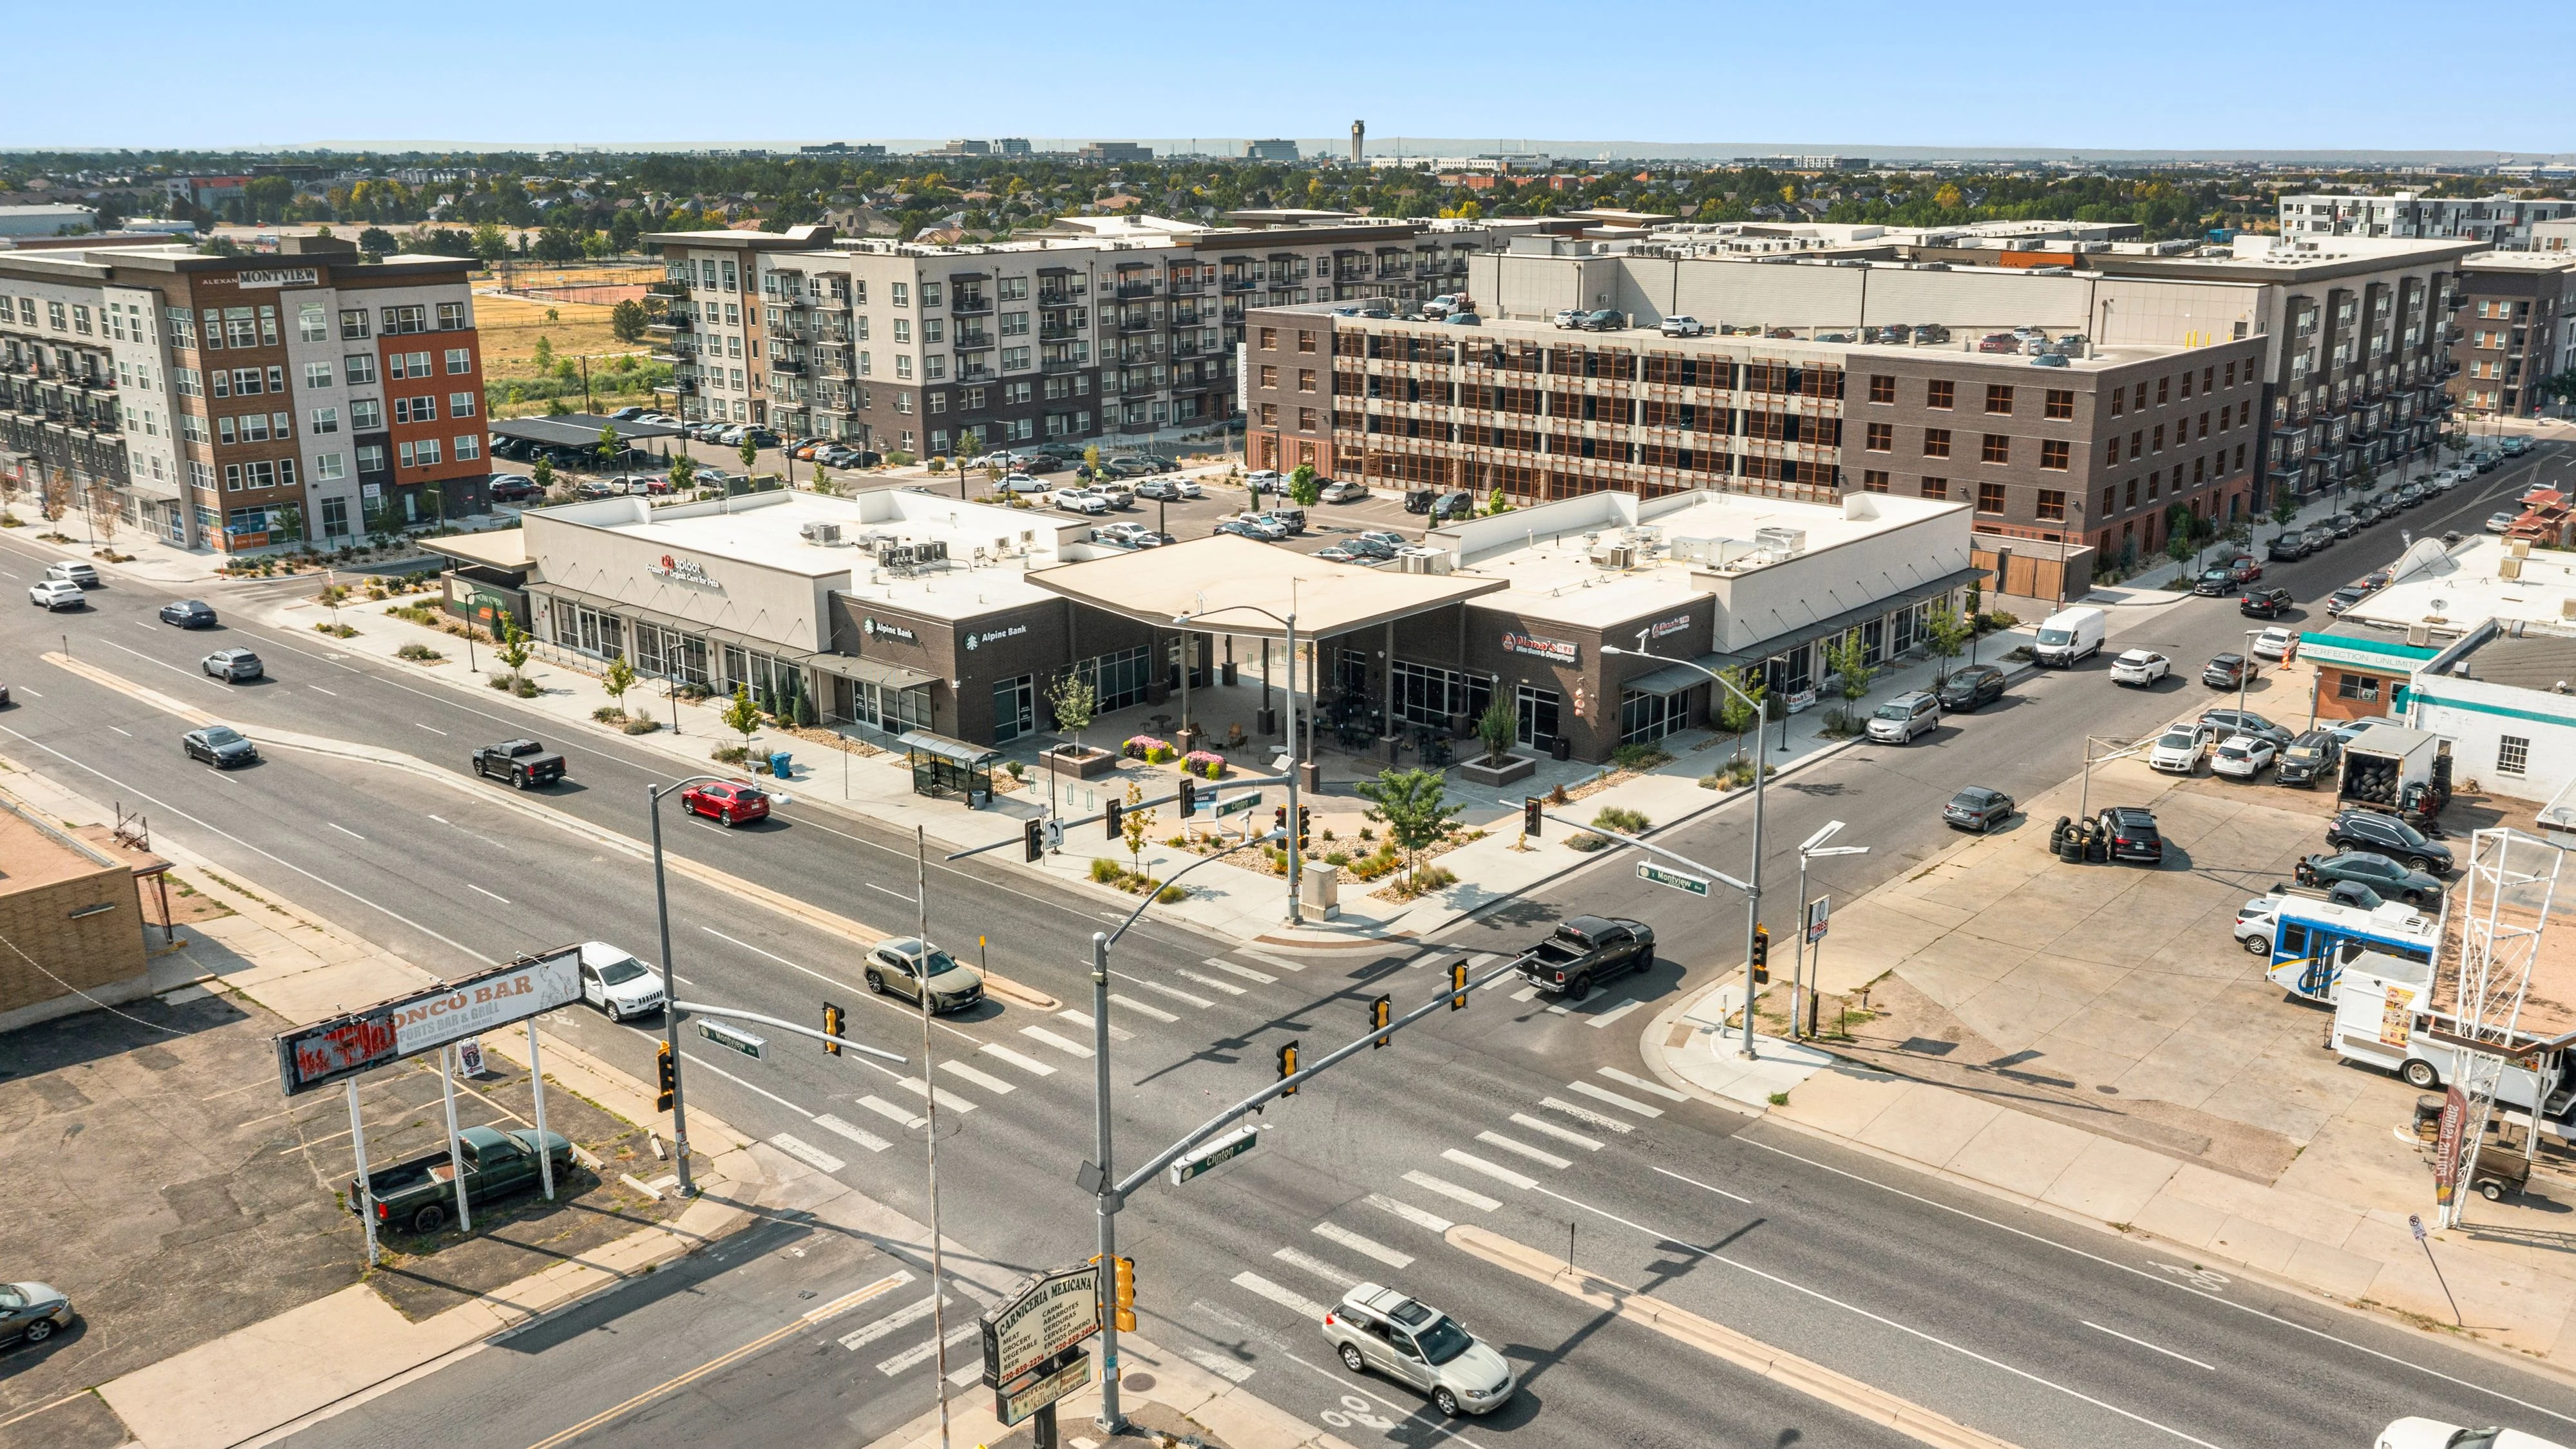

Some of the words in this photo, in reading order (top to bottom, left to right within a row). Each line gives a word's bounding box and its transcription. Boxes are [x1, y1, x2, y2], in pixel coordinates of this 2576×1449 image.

[240, 268, 316, 283] MONTVIEW
[676, 559, 701, 573] sploot
[645, 564, 666, 576] Primary
[670, 569, 687, 580] Urgent
[687, 574, 699, 583] Care
[699, 576, 707, 585] for
[707, 578, 719, 587] Pets
[876, 622, 896, 636] Alpine
[896, 627, 913, 638] Bank
[981, 631, 1007, 643] Alpine
[1008, 625, 1027, 636] Bank
[1517, 636, 1557, 652] Nana's
[1546, 651, 1575, 663] Dumplings
[2307, 647, 2369, 662] PERFECTION
[1048, 838, 1060, 846] ONLY
[1658, 871, 1691, 887] Montview
[1811, 919, 1827, 935] TIRES
[393, 994, 467, 1030] ONCO
[474, 975, 534, 1004] BAR
[437, 1014, 458, 1031] BAR
[461, 1012, 469, 1023] &
[471, 1001, 500, 1019] GRILL
[715, 1031, 745, 1050] Montview
[1207, 1146, 1234, 1166] Clinton
[999, 1290, 1048, 1338] CARNICERIA
[1051, 1277, 1092, 1299] MEXICANA
[1042, 1302, 1063, 1318] CARNE
[1043, 1301, 1079, 1326] ABARROTES
[1043, 1311, 1077, 1333] VERDURAS
[1003, 1331, 1020, 1345] MEAT
[1043, 1322, 1072, 1341] CERVEZA
[1044, 1333, 1067, 1350] ENVIOS
[1068, 1318, 1091, 1336] DINERO
[1001, 1354, 1045, 1383] 720-859-2274
[1055, 1323, 1097, 1353] 720-859-2404
[1002, 1334, 1031, 1354] GROCERY
[1003, 1339, 1038, 1362] VEGETABLE
[1004, 1358, 1019, 1371] BEER
[1061, 1370, 1083, 1385] Mariscos
[1011, 1383, 1044, 1406] Puerto
